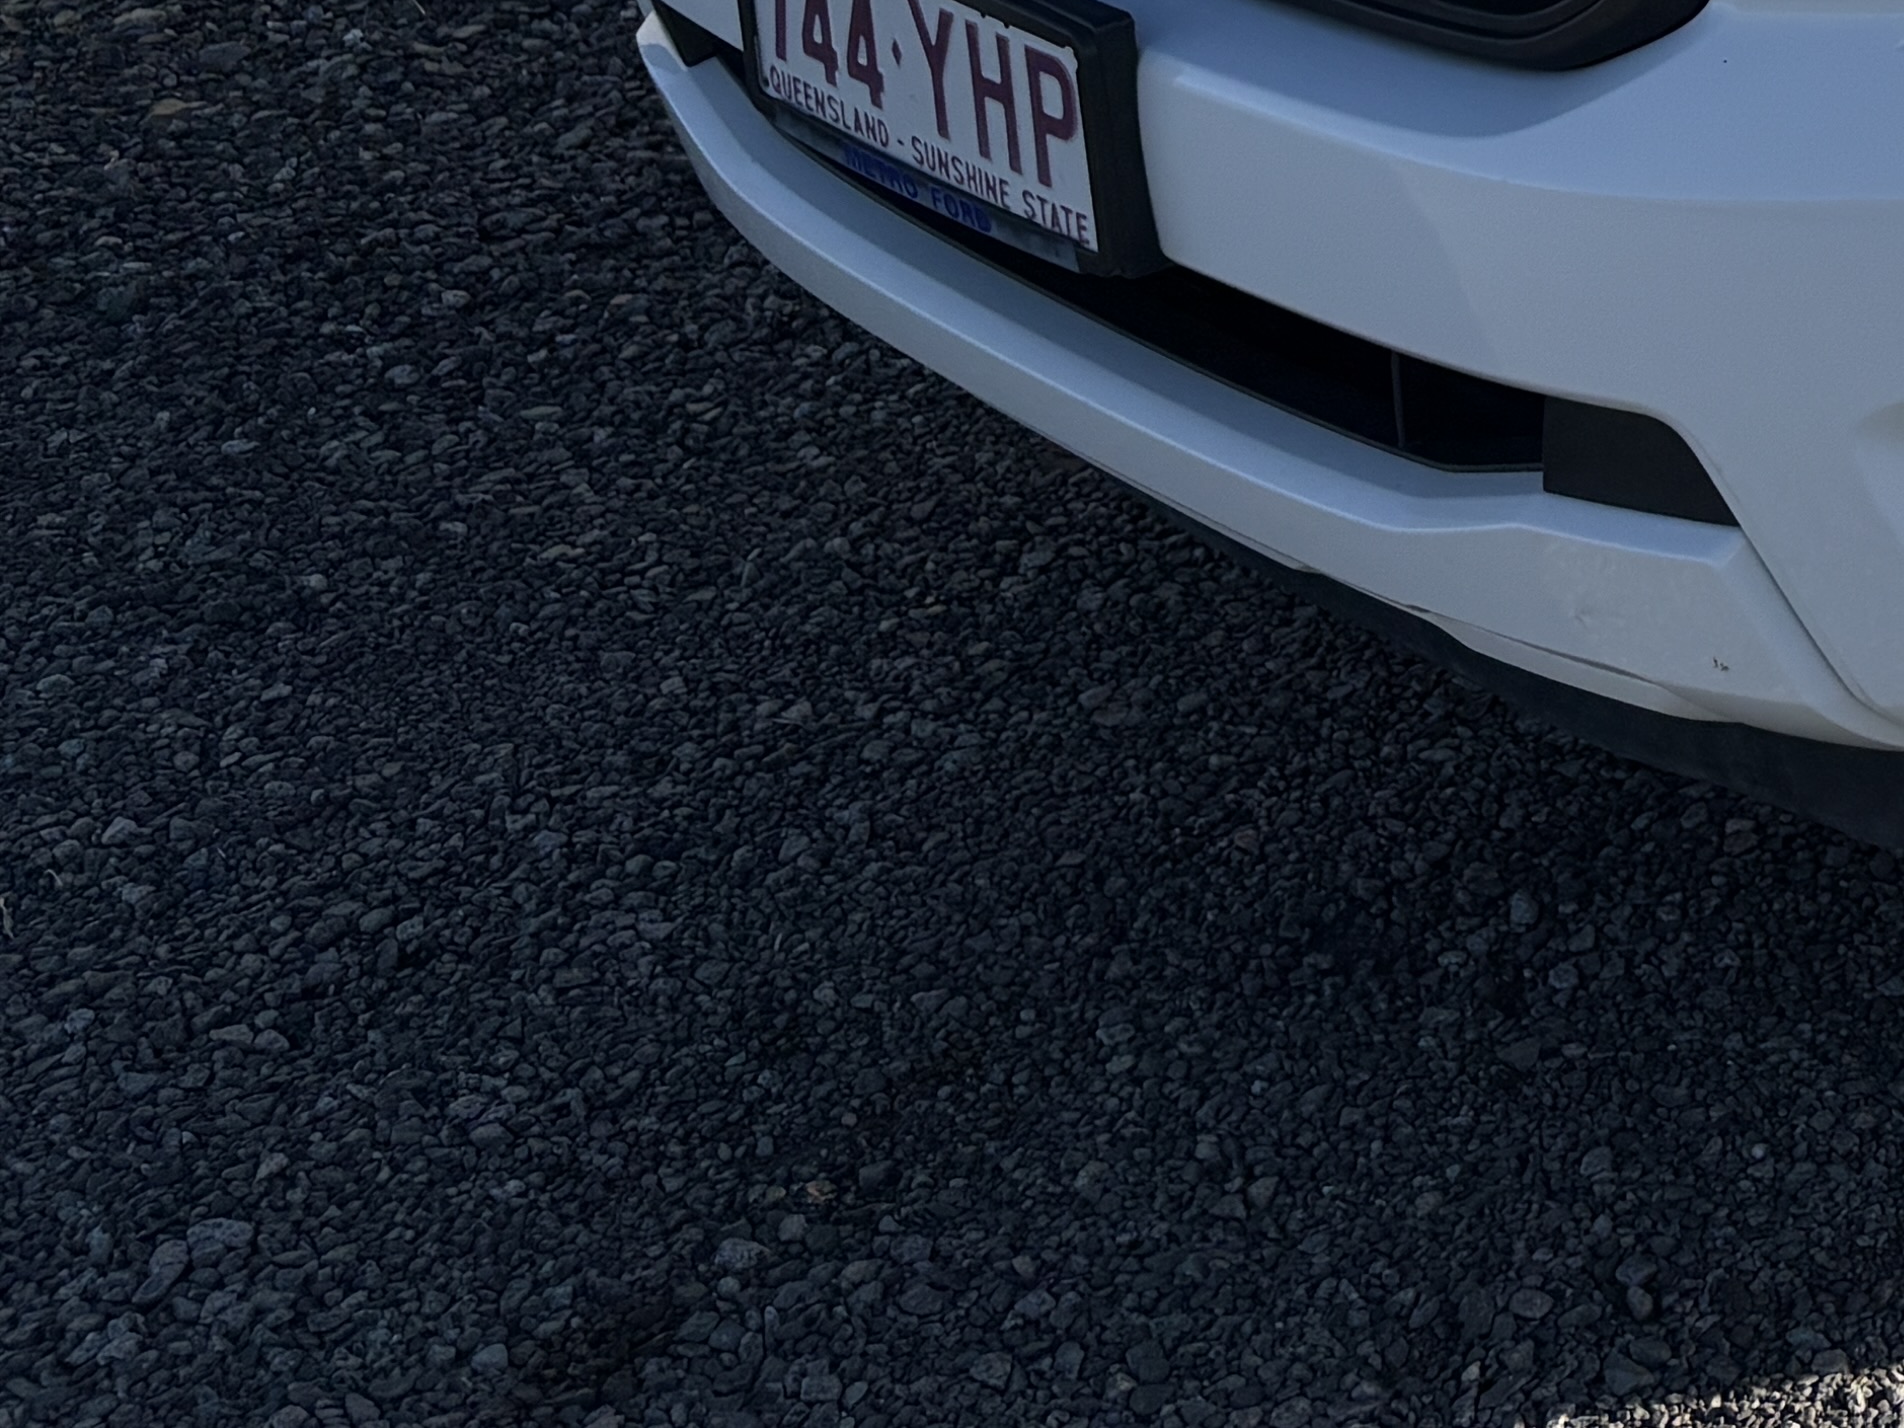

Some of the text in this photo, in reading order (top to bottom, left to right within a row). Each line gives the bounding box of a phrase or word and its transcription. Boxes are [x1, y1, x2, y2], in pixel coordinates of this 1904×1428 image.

[769, 64, 890, 148] QUEENSLAND
[910, 135, 1011, 208] SUNSHINE
[1021, 189, 1090, 246] STATE
[930, 182, 993, 234] FORD
